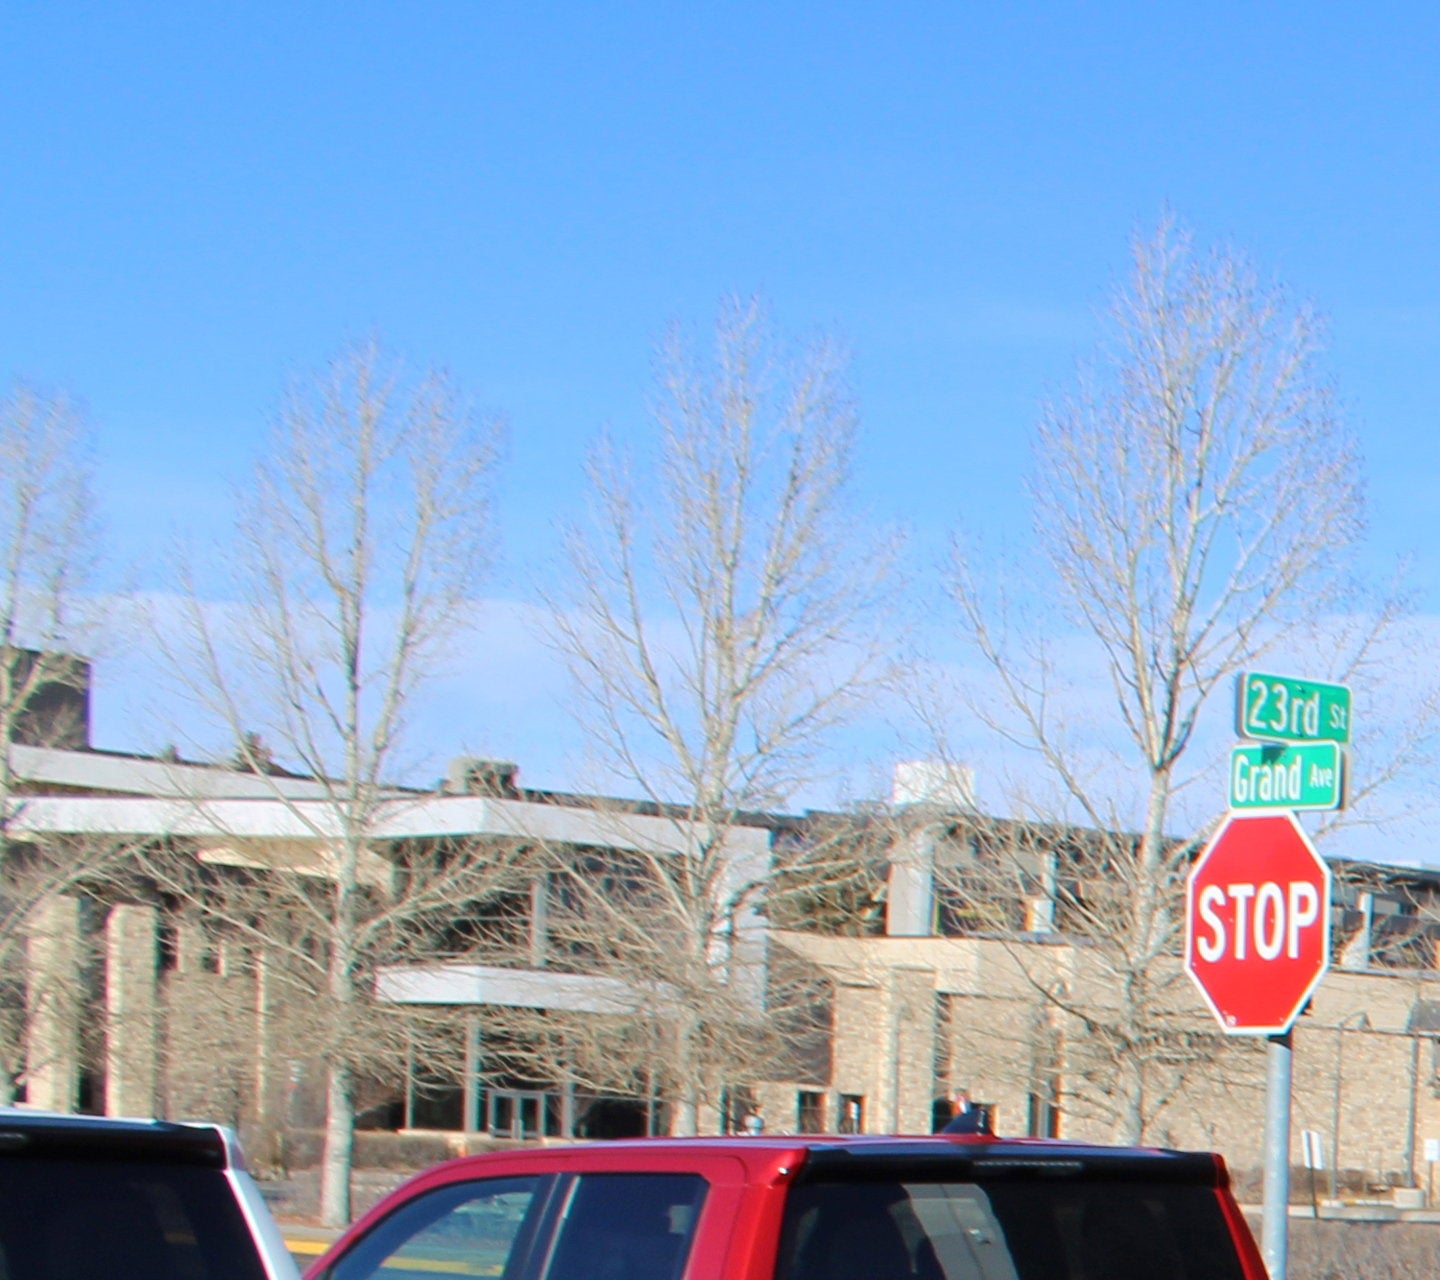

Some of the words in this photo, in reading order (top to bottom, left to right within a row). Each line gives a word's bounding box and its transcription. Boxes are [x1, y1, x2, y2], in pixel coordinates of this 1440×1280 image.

[1247, 678, 1322, 737] 23rd
[1329, 701, 1348, 732] St
[1233, 753, 1303, 803] Grand
[1309, 761, 1334, 789] Ave
[1197, 881, 1320, 963] STOP
